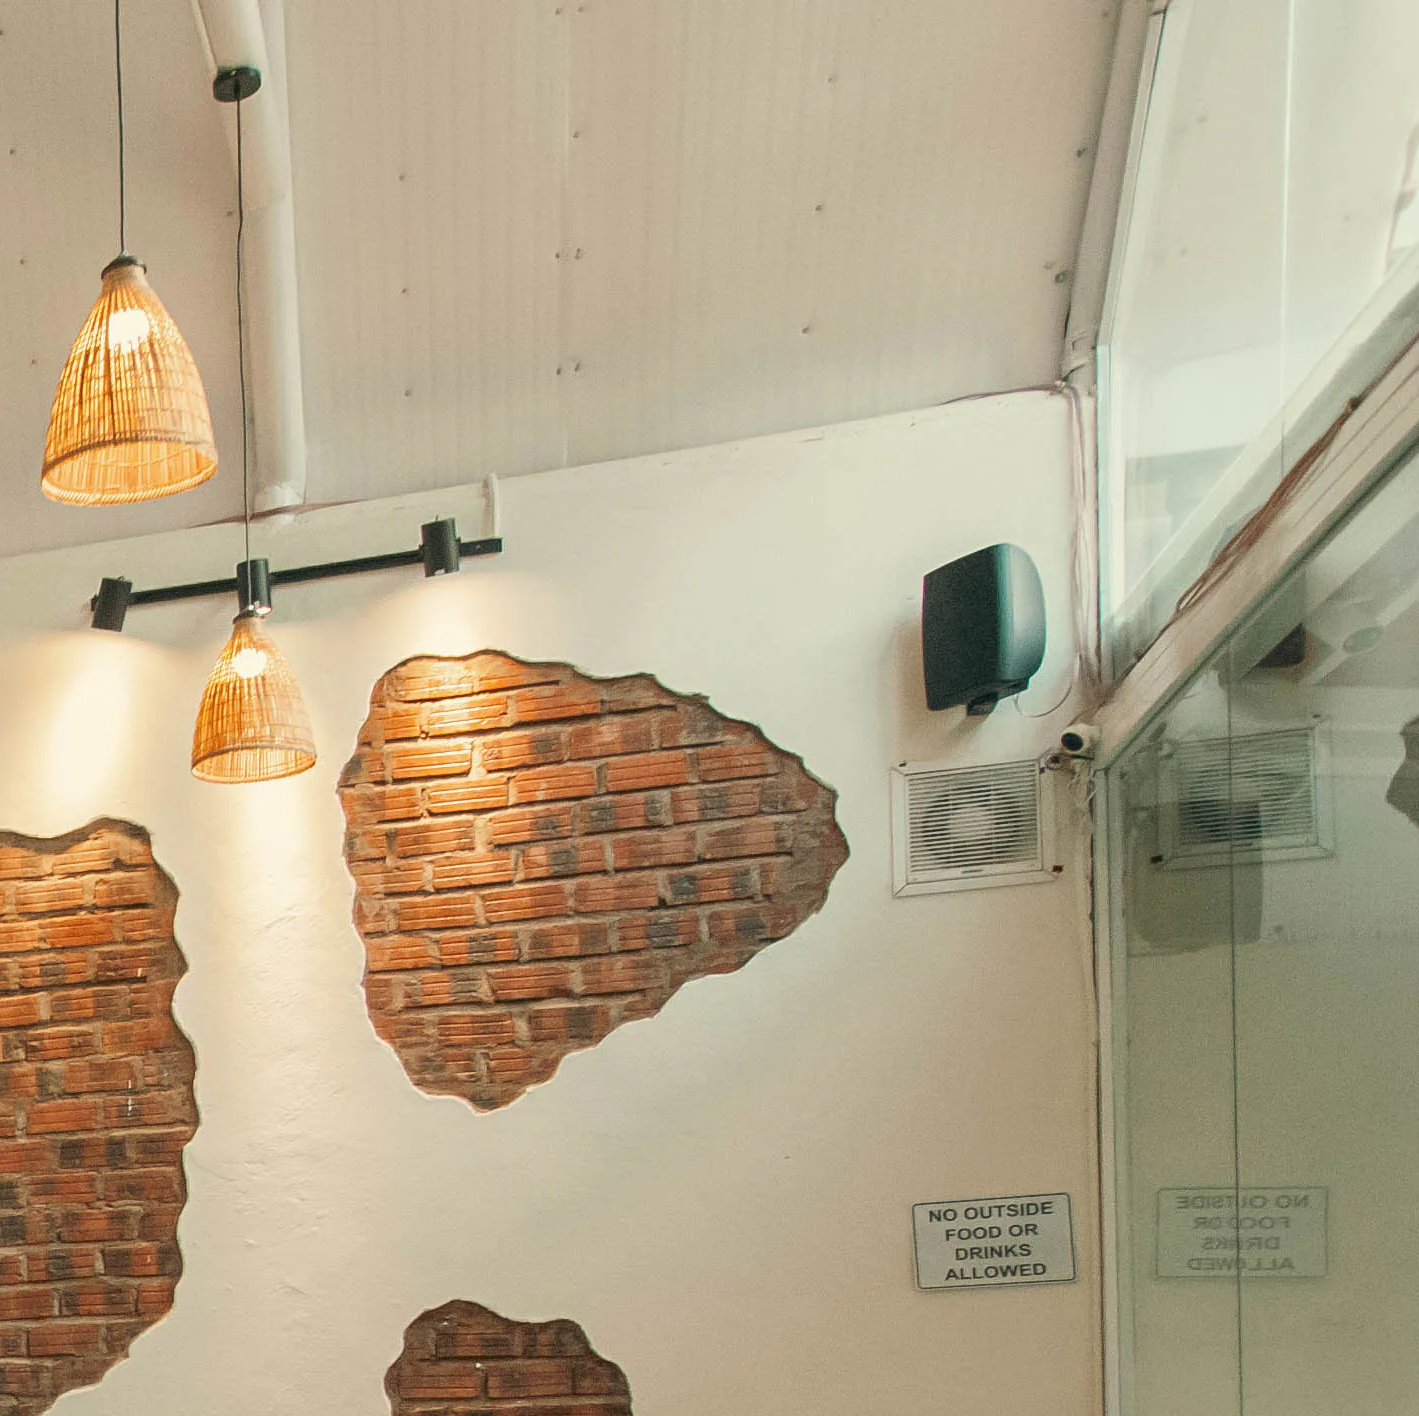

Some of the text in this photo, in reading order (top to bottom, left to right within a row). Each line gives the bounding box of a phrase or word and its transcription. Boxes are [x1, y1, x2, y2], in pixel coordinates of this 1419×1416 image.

[929, 1201, 1054, 1222] NO OUTSIDE
[945, 1223, 1039, 1241] FOOD OR
[955, 1243, 1032, 1261] DRINKS
[945, 1263, 1047, 1281] ALLOWED
